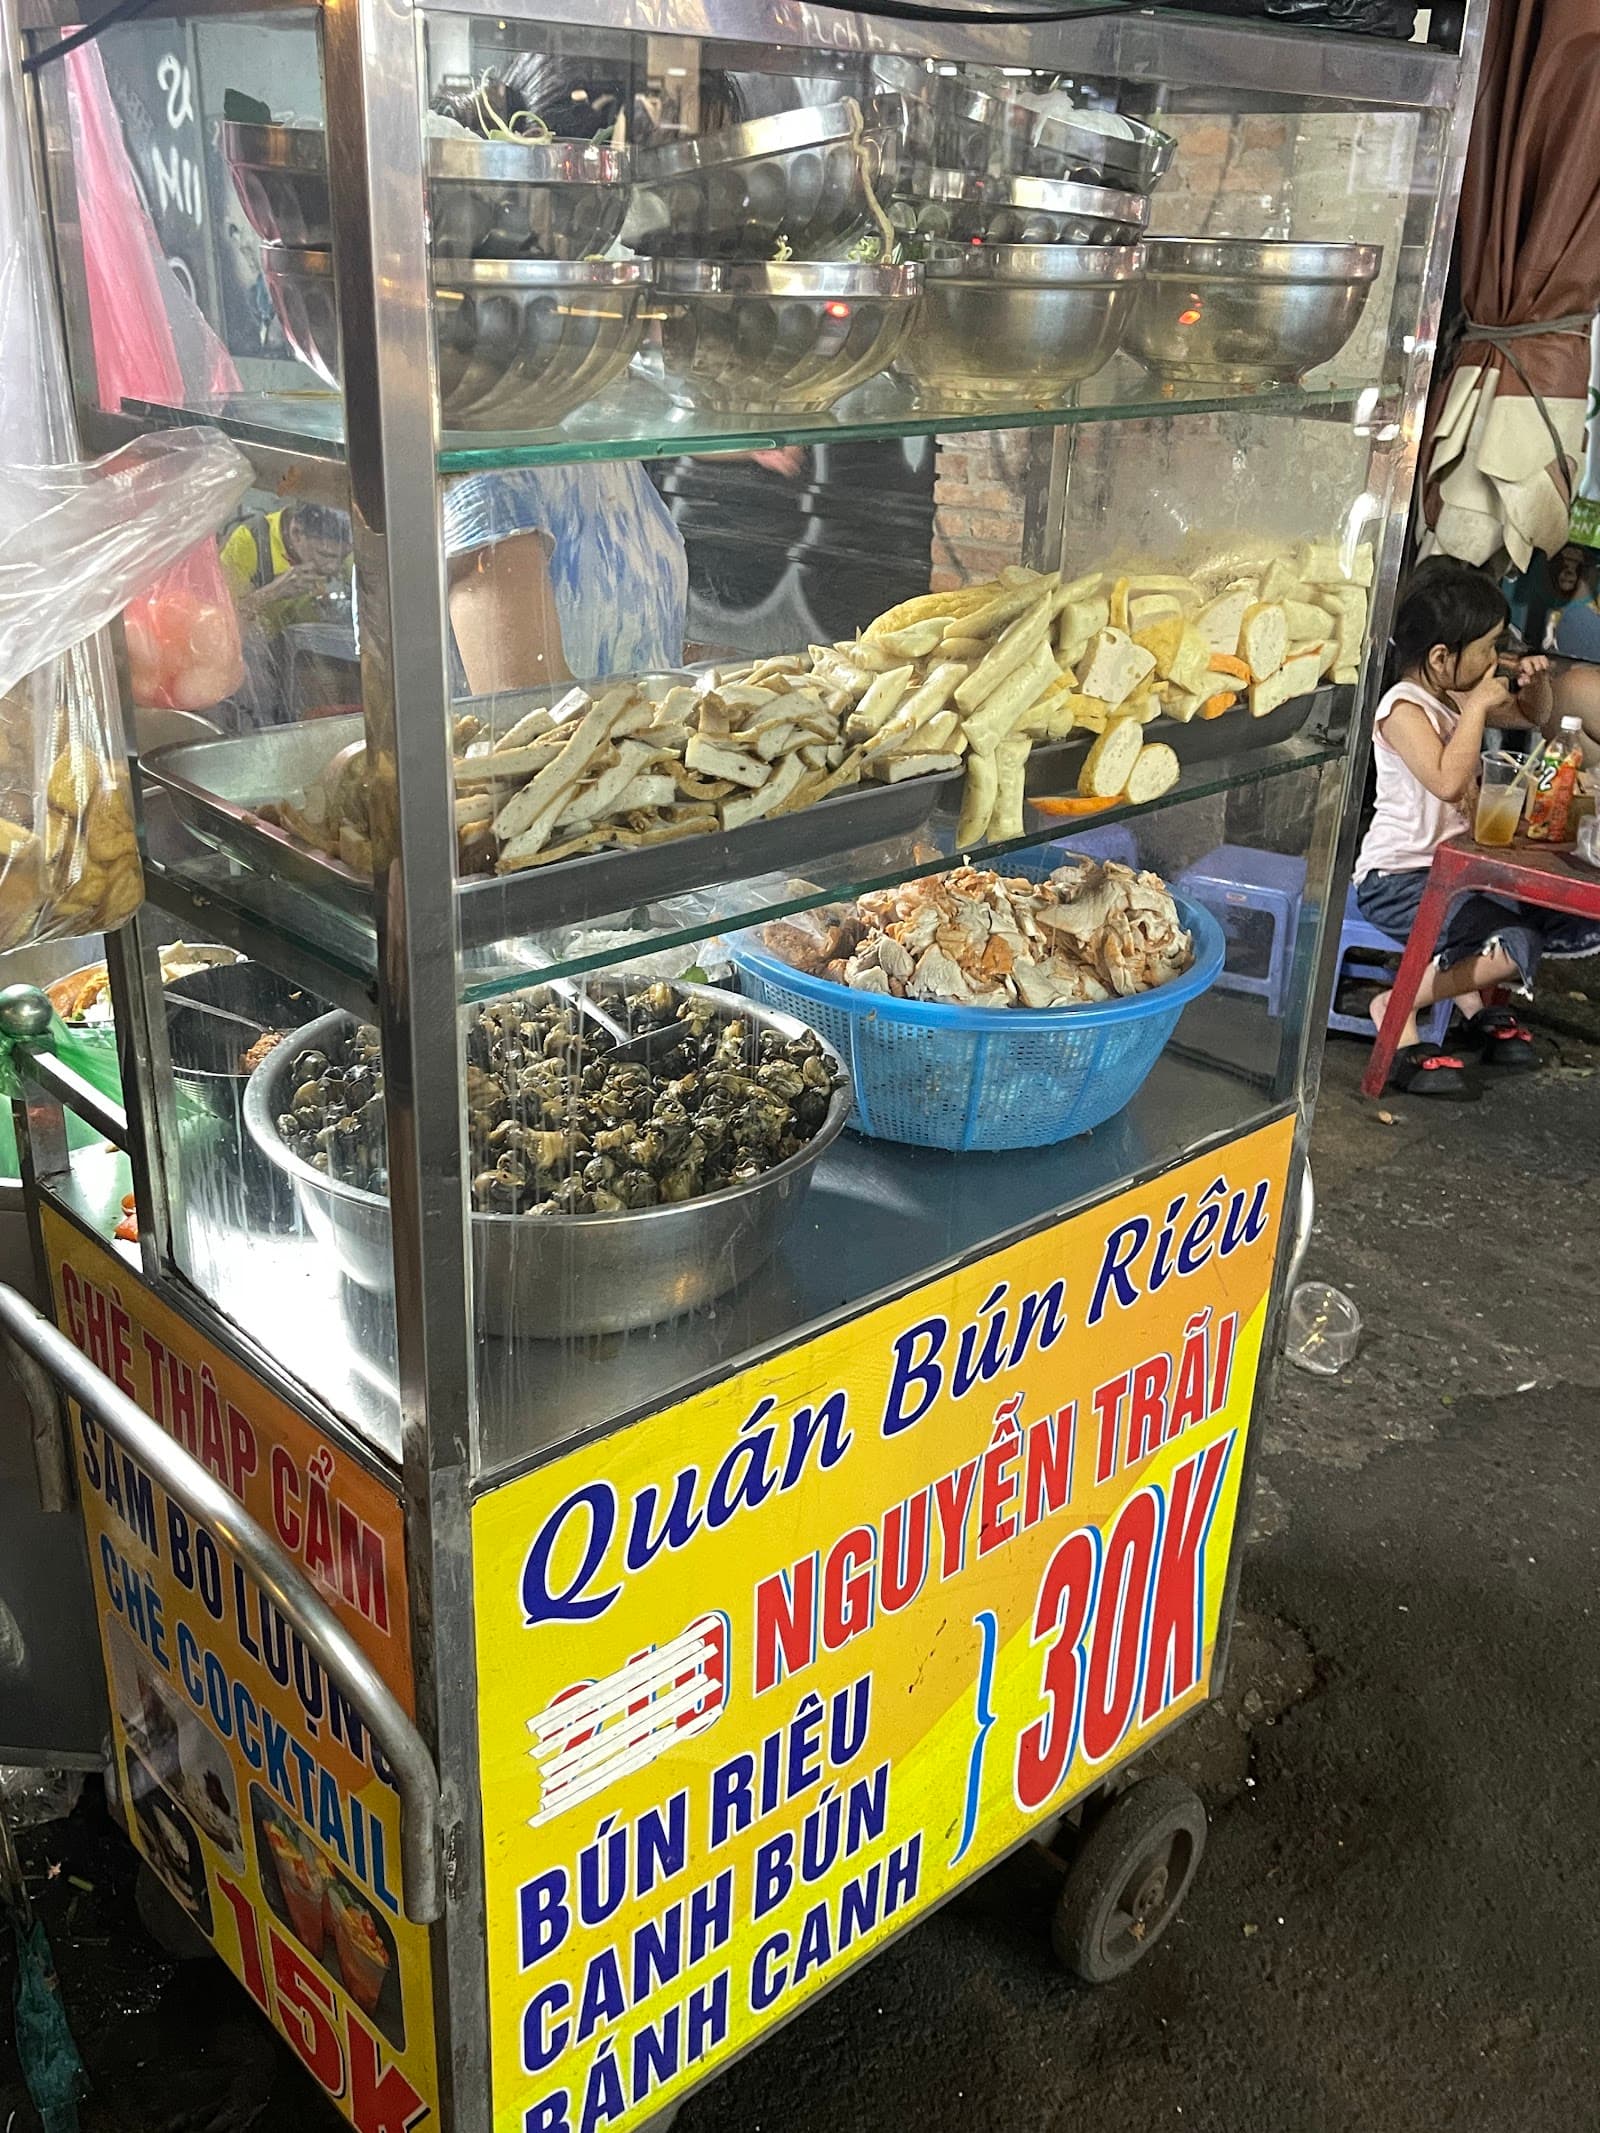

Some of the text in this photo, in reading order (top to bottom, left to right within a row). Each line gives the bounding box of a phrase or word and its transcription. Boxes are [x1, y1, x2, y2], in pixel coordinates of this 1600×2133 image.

[61, 1261, 135, 1401] CHÈ
[269, 1443, 391, 1638] CẢM
[520, 1174, 1269, 1628] Quán Bún Riêu
[752, 1306, 1239, 1698] NGUYỄN TRÃI
[100, 1533, 399, 1917] CHÈ COCKTAIL
[1014, 1428, 1239, 1812] 30K
[215, 1871, 432, 2133] 15K
[519, 1788, 686, 1971] BÚN
[711, 1673, 873, 1849] RIÊU
[520, 1762, 890, 2074] CANH BÚN
[749, 1832, 923, 2014] CANH
